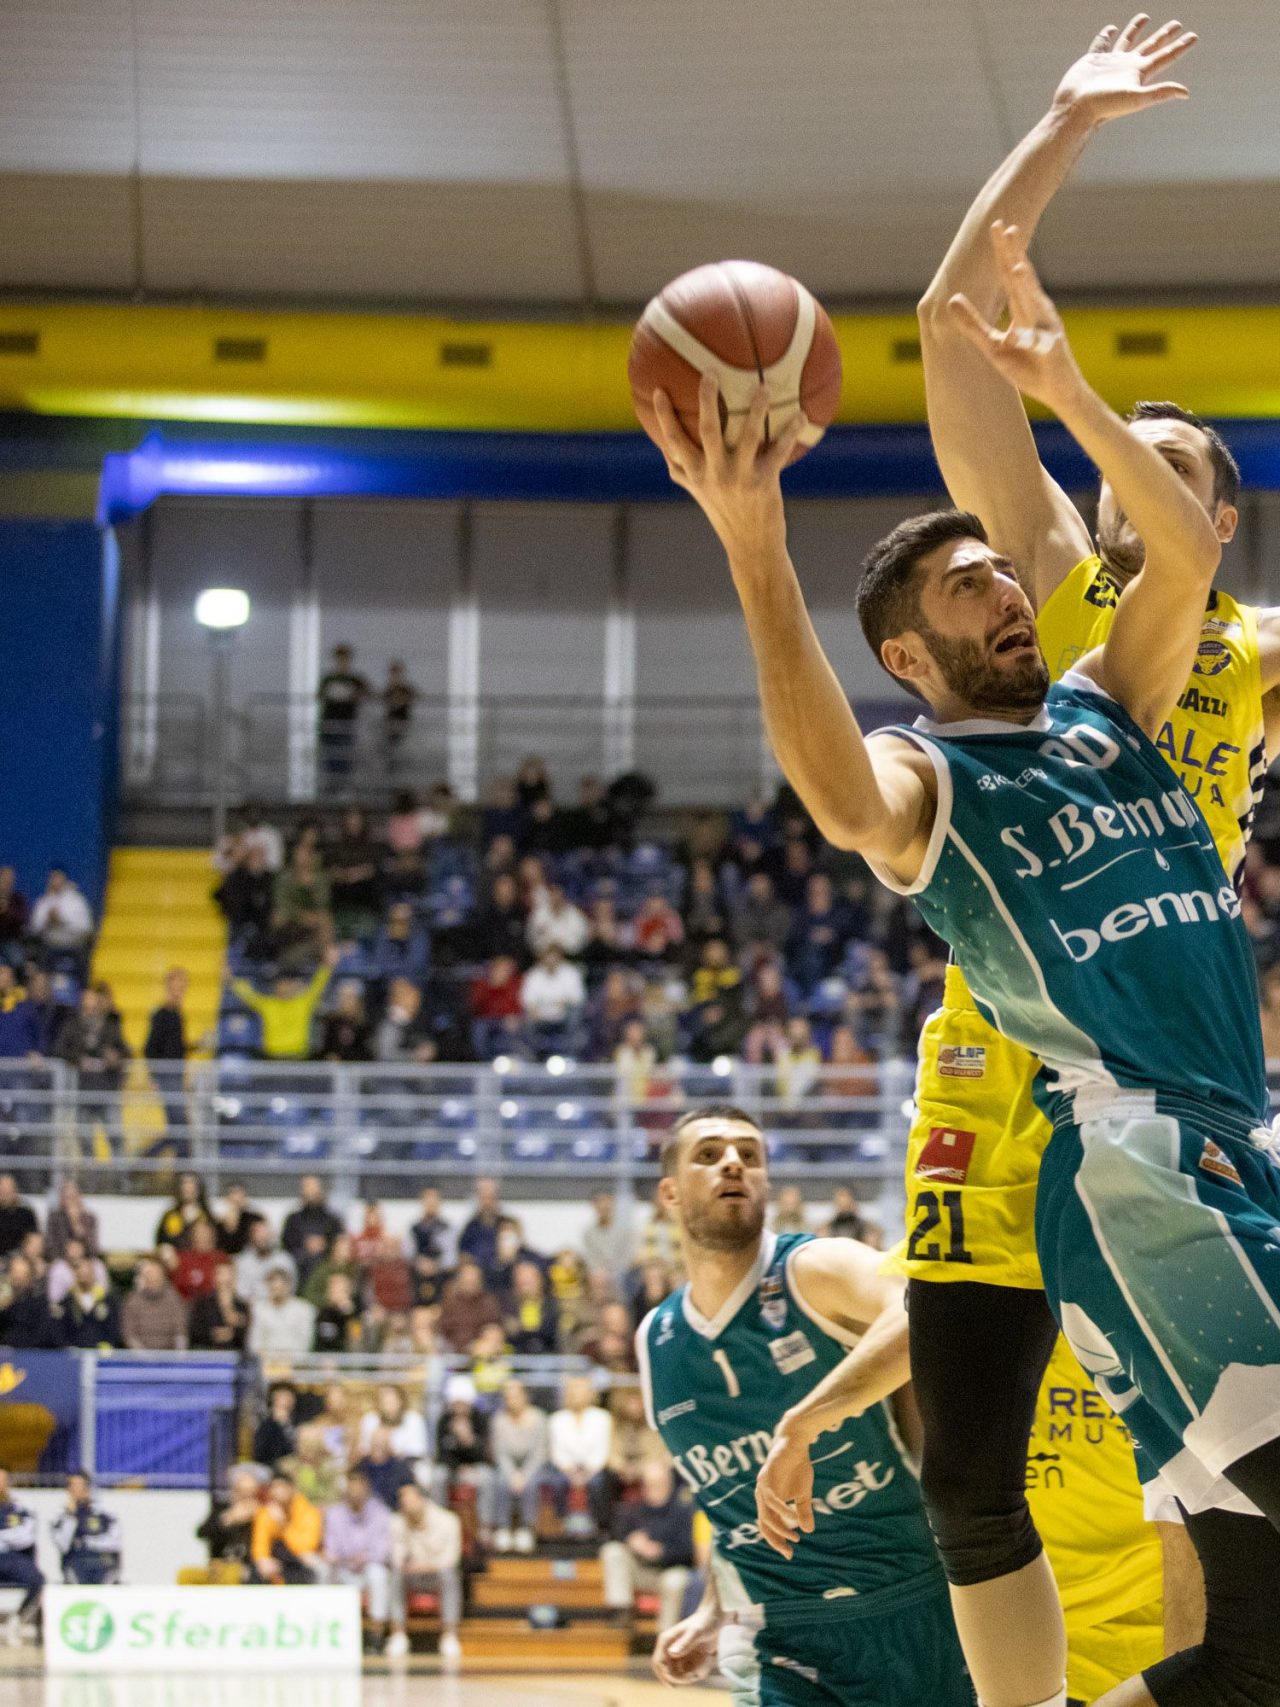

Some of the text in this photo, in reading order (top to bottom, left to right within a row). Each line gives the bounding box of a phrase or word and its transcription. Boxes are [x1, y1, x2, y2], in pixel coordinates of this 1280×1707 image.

[1156, 721, 1240, 776] ALE
[1049, 886, 1242, 963] benne
[907, 1190, 973, 1264] 21
[713, 1349, 740, 1397] 1
[1049, 1387, 1116, 1419] RE
[127, 1609, 345, 1650] Sferabit
